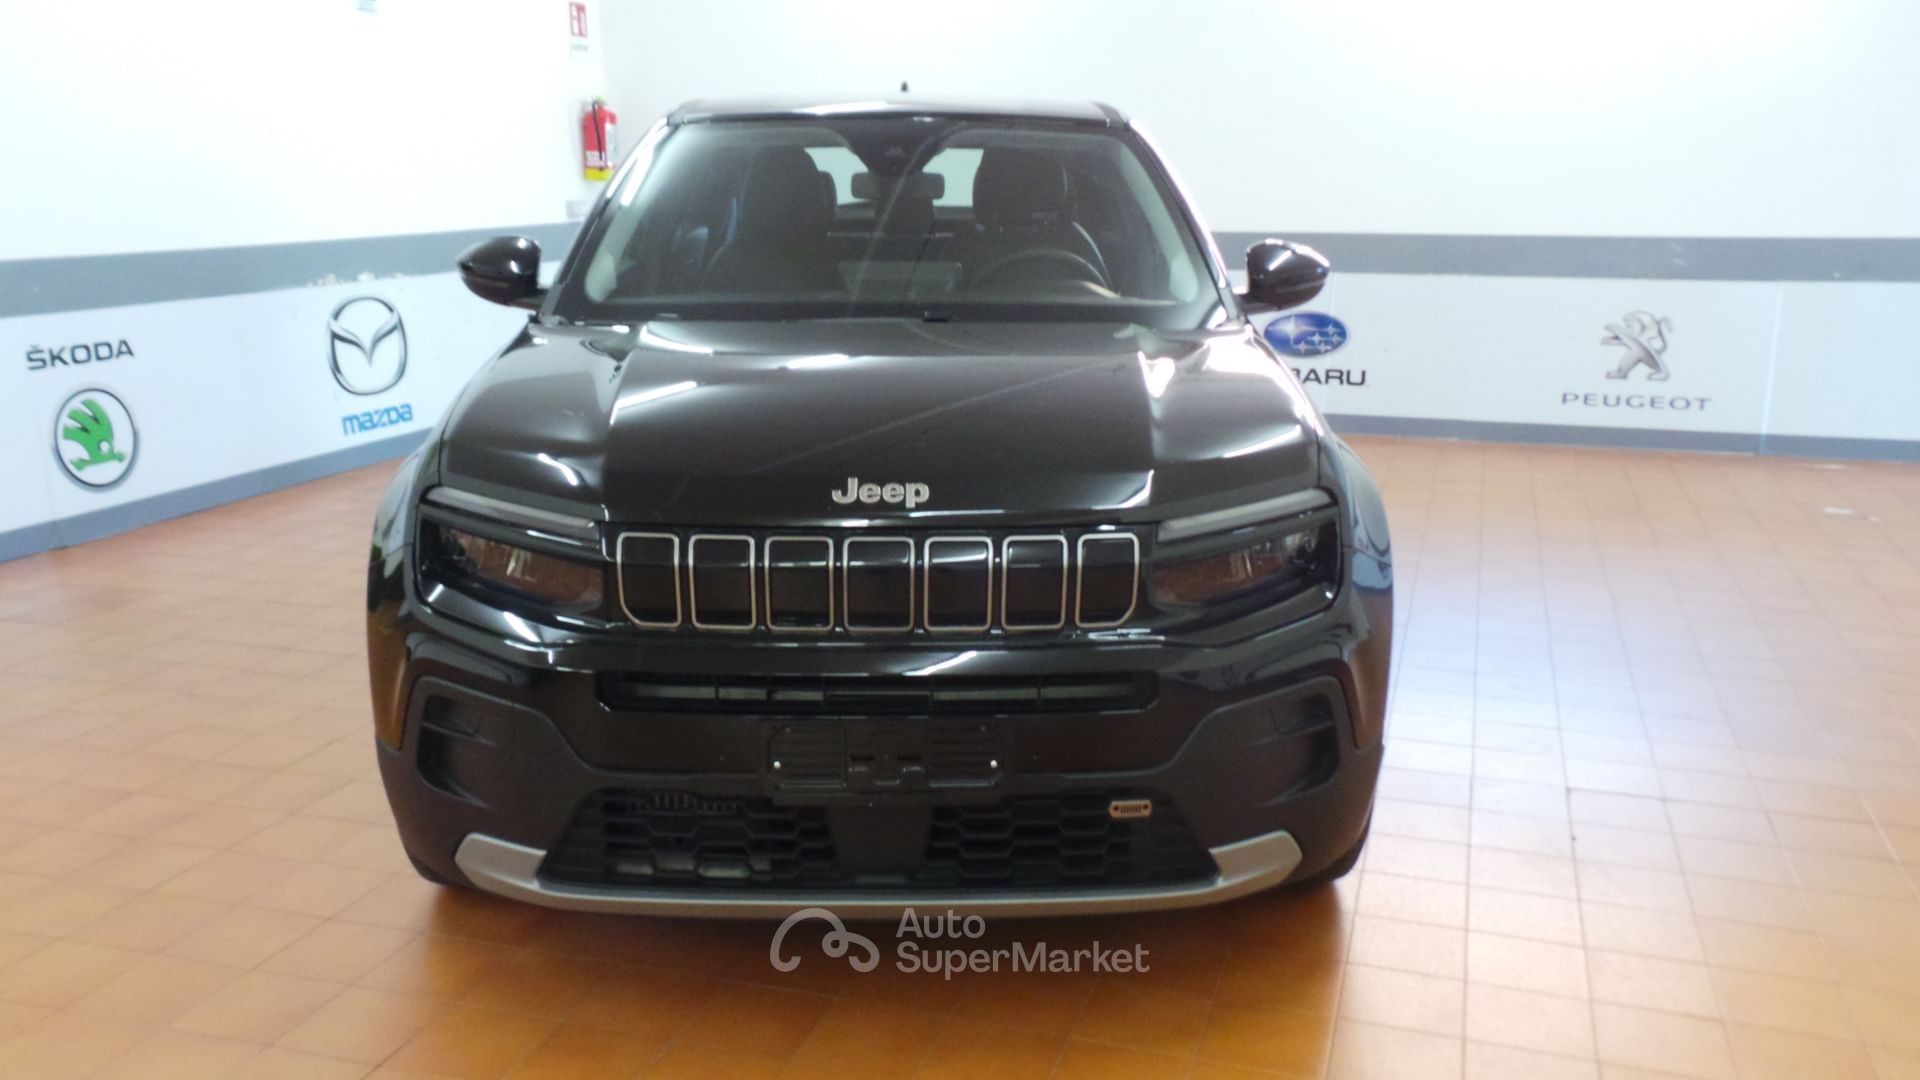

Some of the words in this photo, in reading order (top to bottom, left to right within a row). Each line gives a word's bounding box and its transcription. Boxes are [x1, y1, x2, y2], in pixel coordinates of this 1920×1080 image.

[26, 339, 135, 371] ŠKODA
[1561, 392, 1712, 411] PEUGEOT
[831, 476, 930, 509] Jeep
